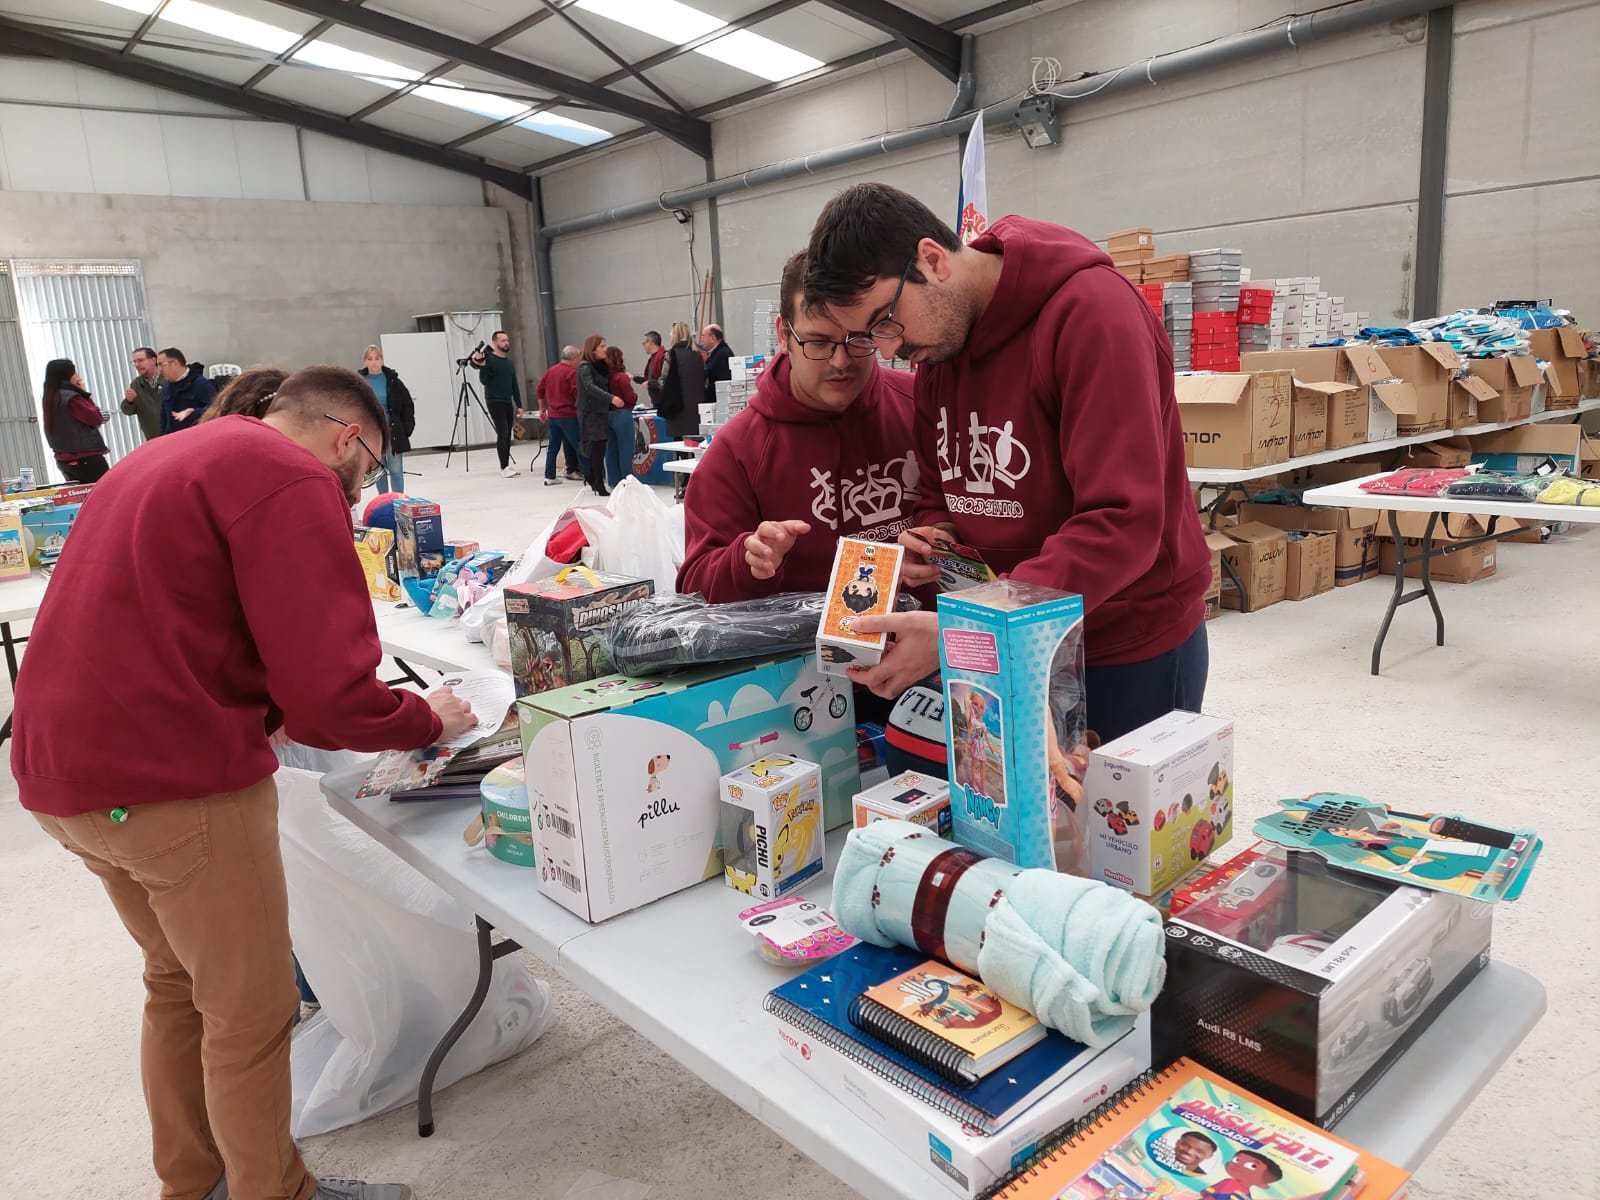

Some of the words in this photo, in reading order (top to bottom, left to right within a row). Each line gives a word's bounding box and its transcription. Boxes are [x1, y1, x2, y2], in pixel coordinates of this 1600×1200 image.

[1183, 432, 1221, 444] JOLU
[900, 689, 945, 722] FILA
[637, 798, 680, 829] pillu
[755, 825, 769, 869] PICHU
[1197, 1018, 1220, 1035] Audi
[1238, 1034, 1262, 1052] LMS
